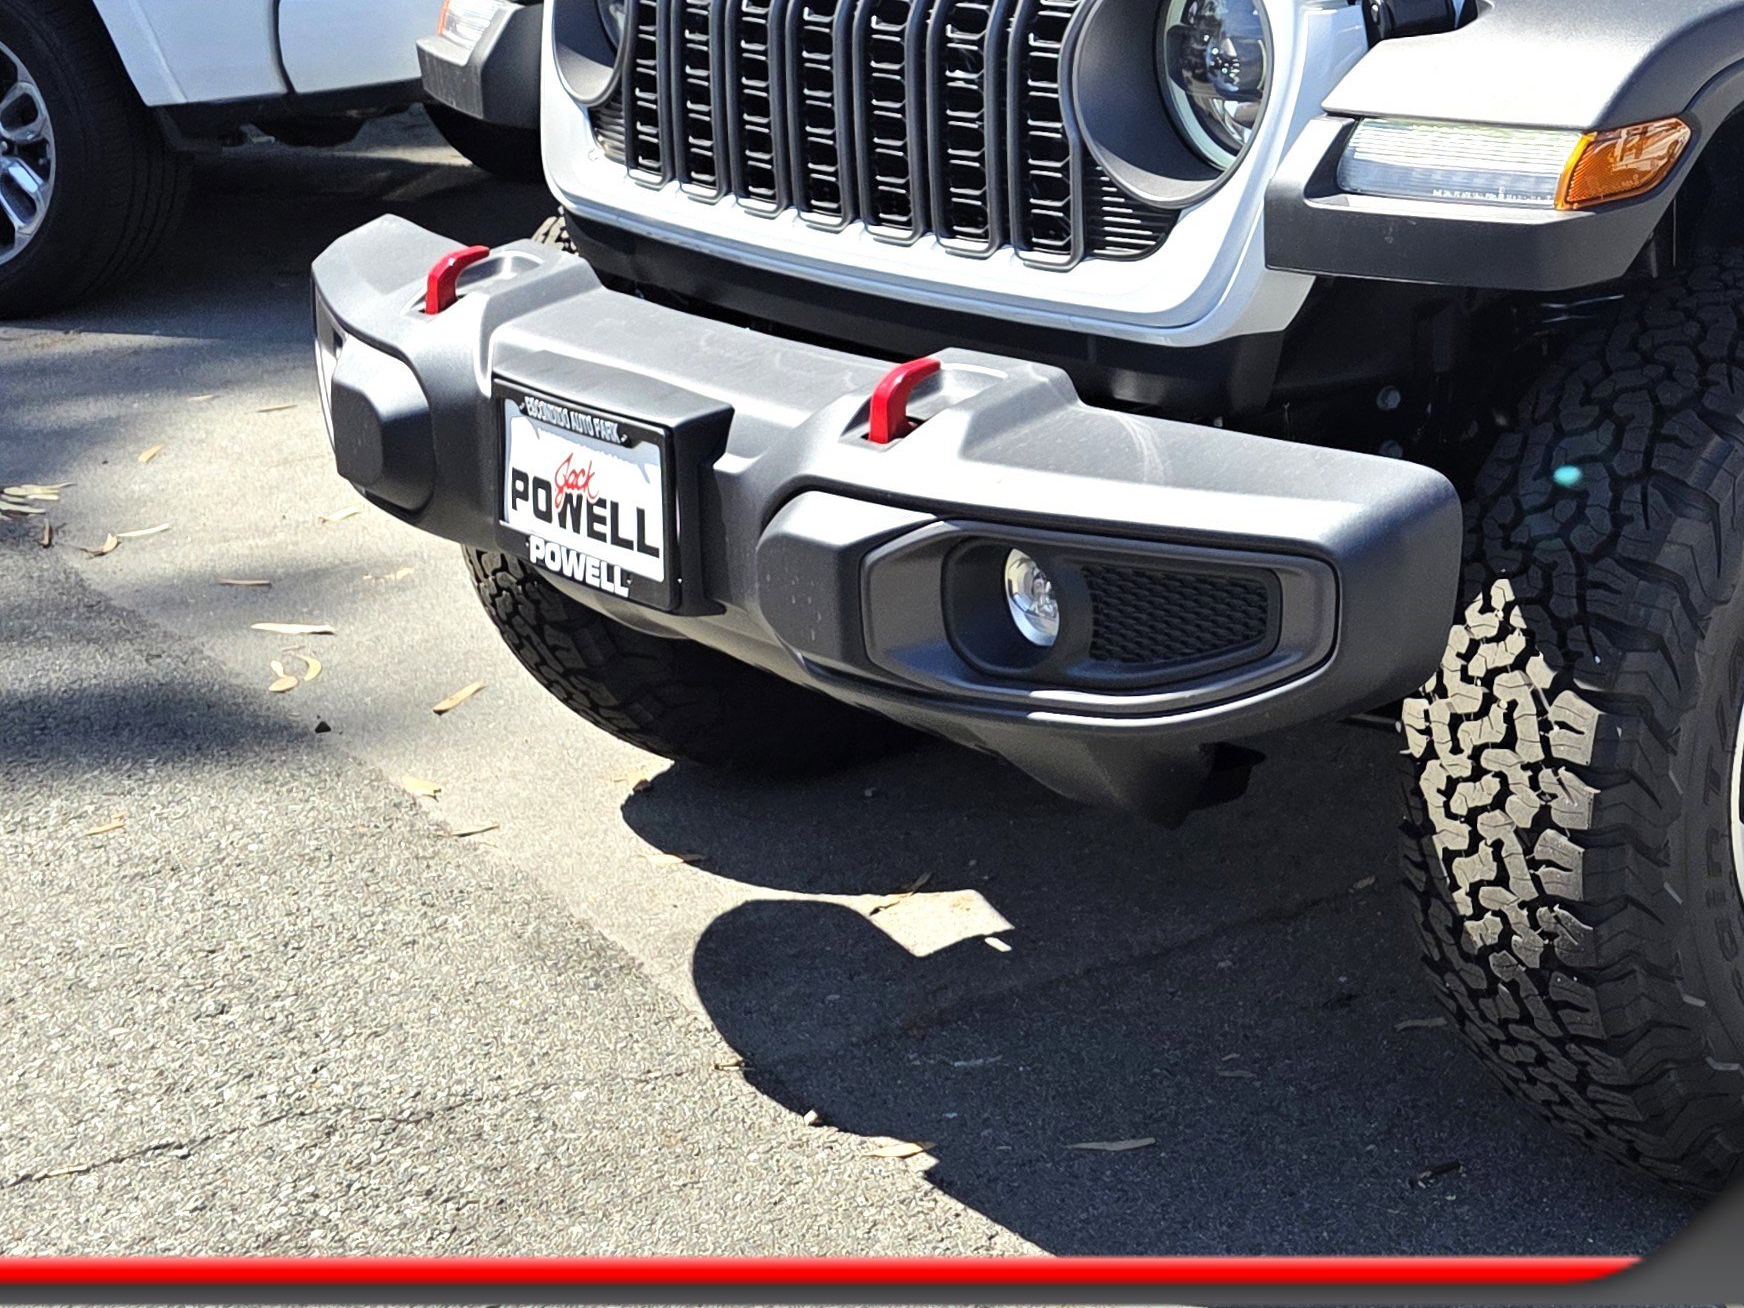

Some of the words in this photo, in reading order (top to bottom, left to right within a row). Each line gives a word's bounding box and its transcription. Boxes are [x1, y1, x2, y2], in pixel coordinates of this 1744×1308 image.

[569, 410, 595, 437] AUTO
[592, 417, 621, 444] PARK
[554, 452, 600, 509] Jack
[511, 467, 661, 559] POWELL
[528, 535, 630, 598] POWELL
